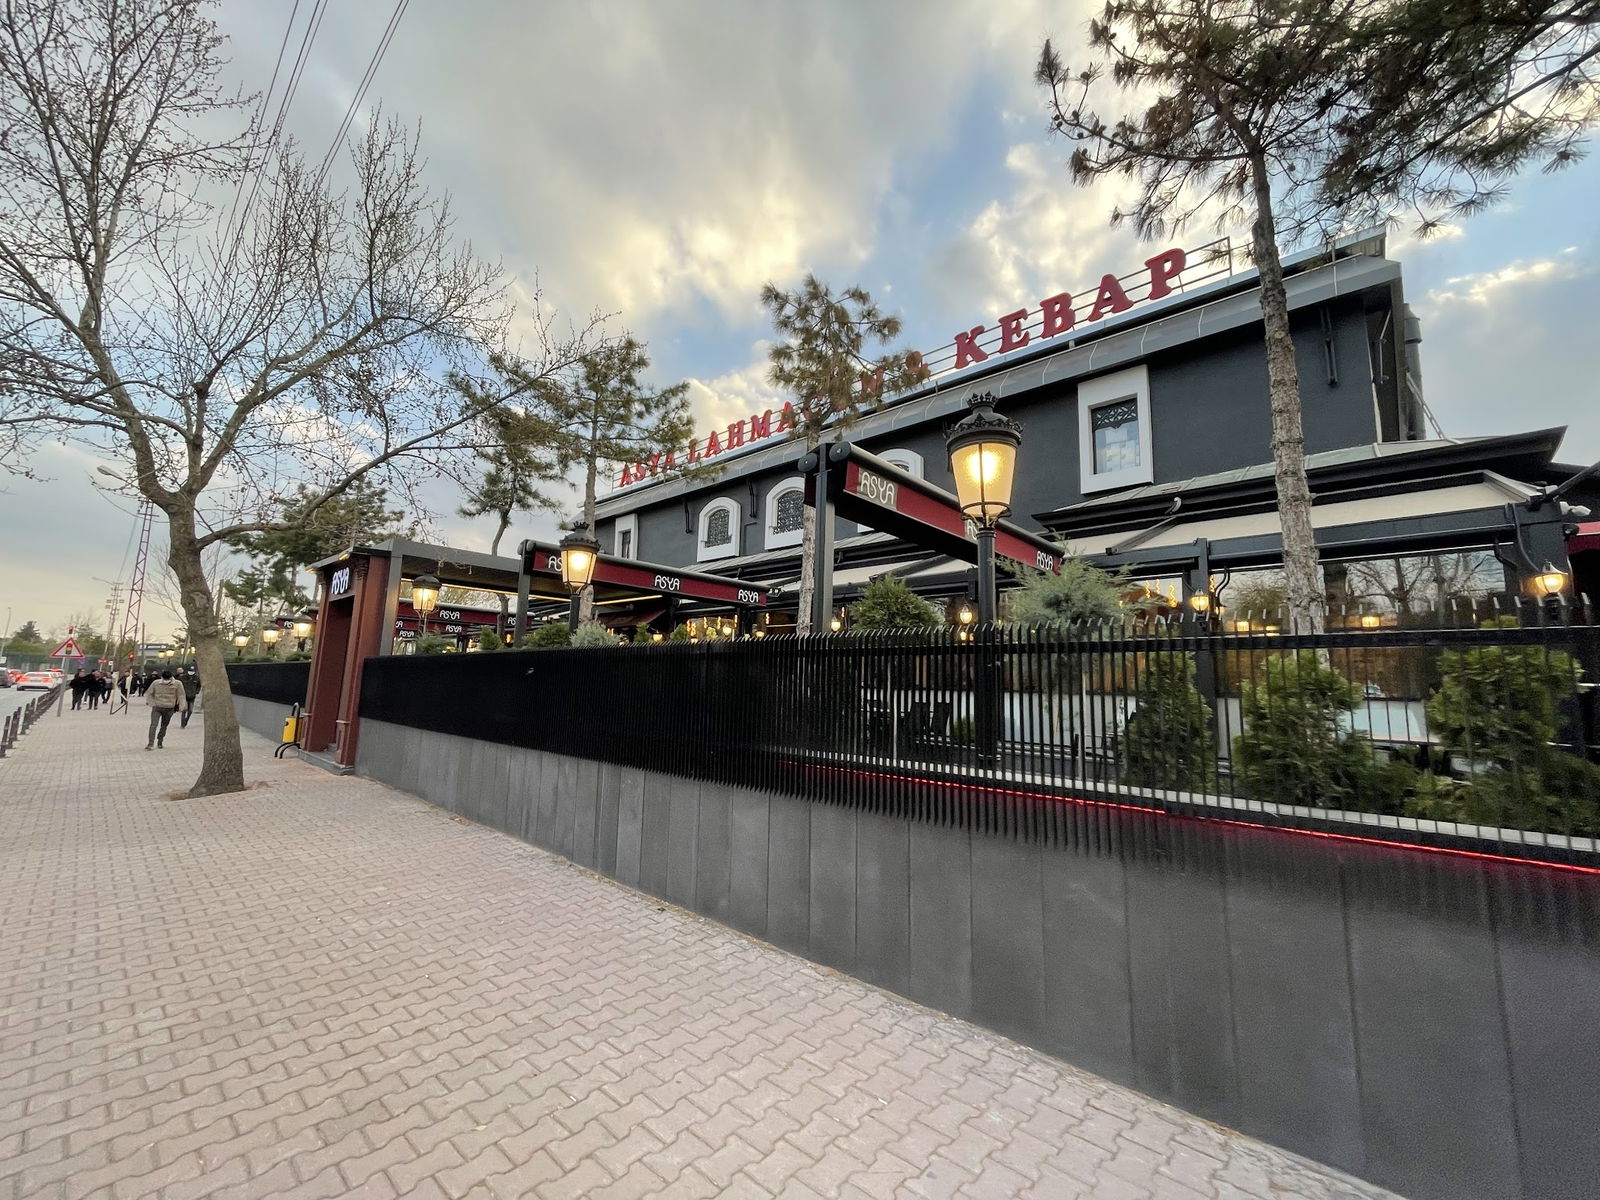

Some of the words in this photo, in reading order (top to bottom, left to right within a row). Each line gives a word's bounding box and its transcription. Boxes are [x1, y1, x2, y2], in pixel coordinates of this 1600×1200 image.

[954, 248, 1186, 370] KEBAP
[861, 471, 896, 505] ASYA
[548, 556, 562, 571] AS
[1036, 550, 1054, 570] ASYA
[331, 567, 350, 594] ASYA
[655, 575, 680, 590] ASYA
[738, 589, 759, 603] ASYA
[440, 610, 460, 619] ASYA
